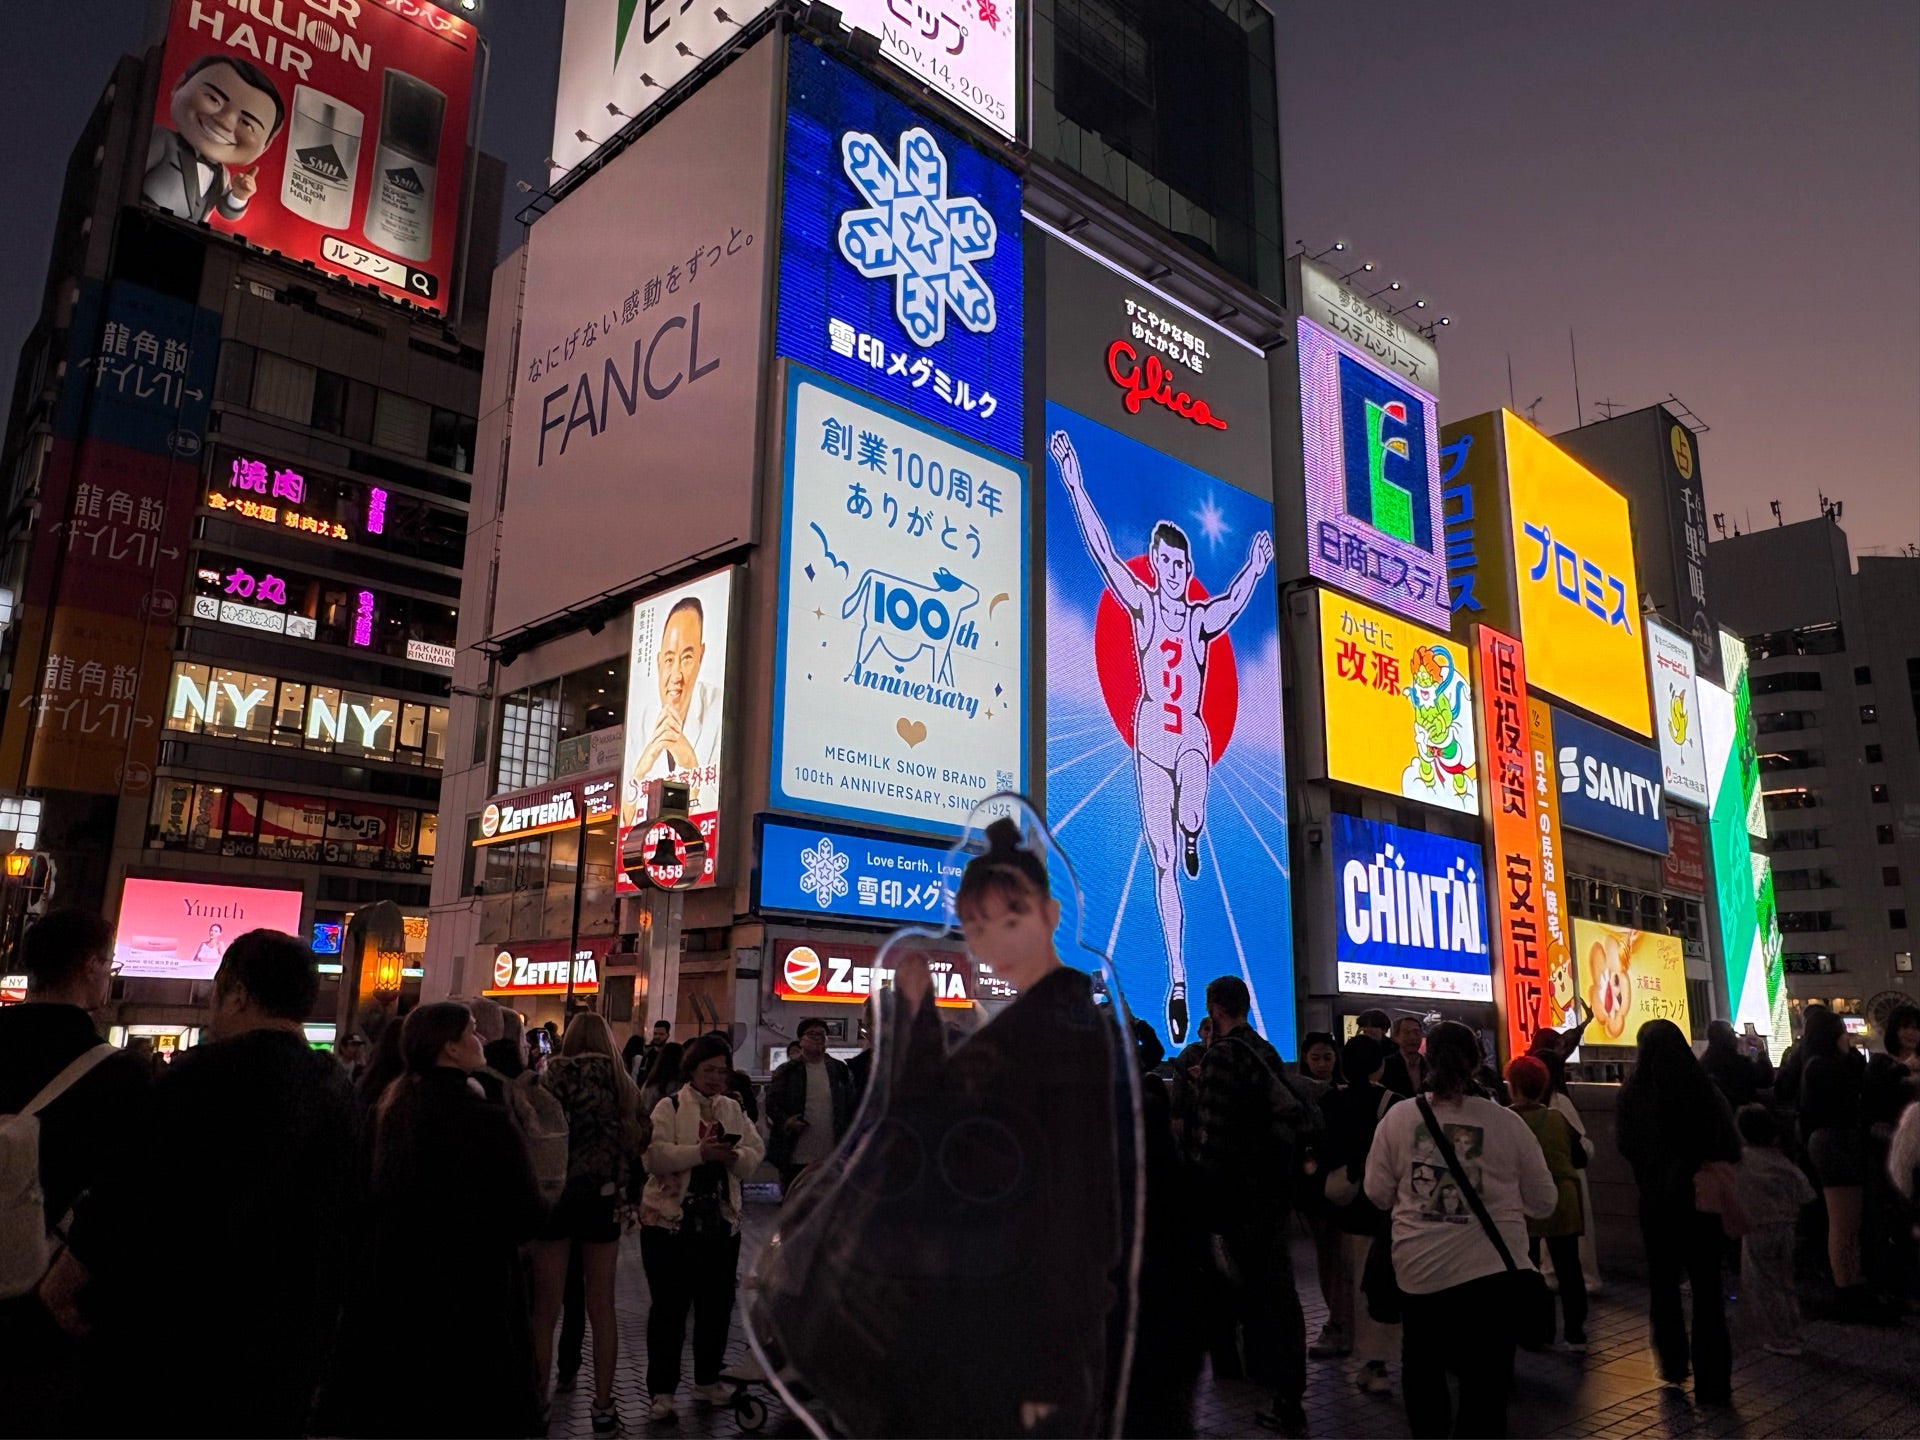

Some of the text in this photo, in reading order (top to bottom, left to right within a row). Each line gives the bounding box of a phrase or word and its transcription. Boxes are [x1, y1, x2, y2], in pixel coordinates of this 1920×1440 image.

[188, 0, 313, 81] HAIR
[882, 21, 925, 67] Nov.
[960, 77, 1005, 120] 2025
[291, 179, 326, 202] MILLION
[293, 172, 324, 192] SUPER
[308, 156, 340, 176] SMH
[290, 188, 313, 205] HAIR
[330, 244, 391, 275] ルアン
[528, 226, 755, 383] なにげない感動をずっと。
[1124, 298, 1211, 359] すこやかな毎日、
[102, 321, 189, 373] 龍角散
[829, 317, 998, 419] 雪印メグミルク
[1131, 322, 1203, 374] ゆたかな人生
[1326, 308, 1420, 382] エステムシリーズ
[537, 302, 720, 467] FANCL
[1107, 340, 1228, 430] Glico
[230, 456, 305, 504] 焼肉
[820, 417, 1004, 518] 創業100周年
[74, 482, 165, 532] 龍角散
[846, 482, 982, 559] ありがとう
[1680, 486, 1707, 607] 千里眼
[224, 567, 287, 605] 力丸
[1523, 520, 1633, 637] プロミス
[408, 641, 455, 657] YAKINIK
[1340, 609, 1395, 651] かぜに
[44, 653, 141, 701] 龍角散
[843, 662, 980, 719] Anniversary
[1159, 636, 1184, 736] グリコ
[1335, 638, 1402, 697] 改源
[172, 674, 393, 748] NY NY
[794, 766, 834, 786] 100th
[824, 745, 987, 790] MEGMILK SNOW BRAND
[1583, 755, 1661, 821] SAMTY
[500, 798, 576, 834] ZETTERIA
[700, 818, 717, 836] 2F
[867, 852, 963, 877] Love Earth. Love
[183, 897, 245, 920] Yunth
